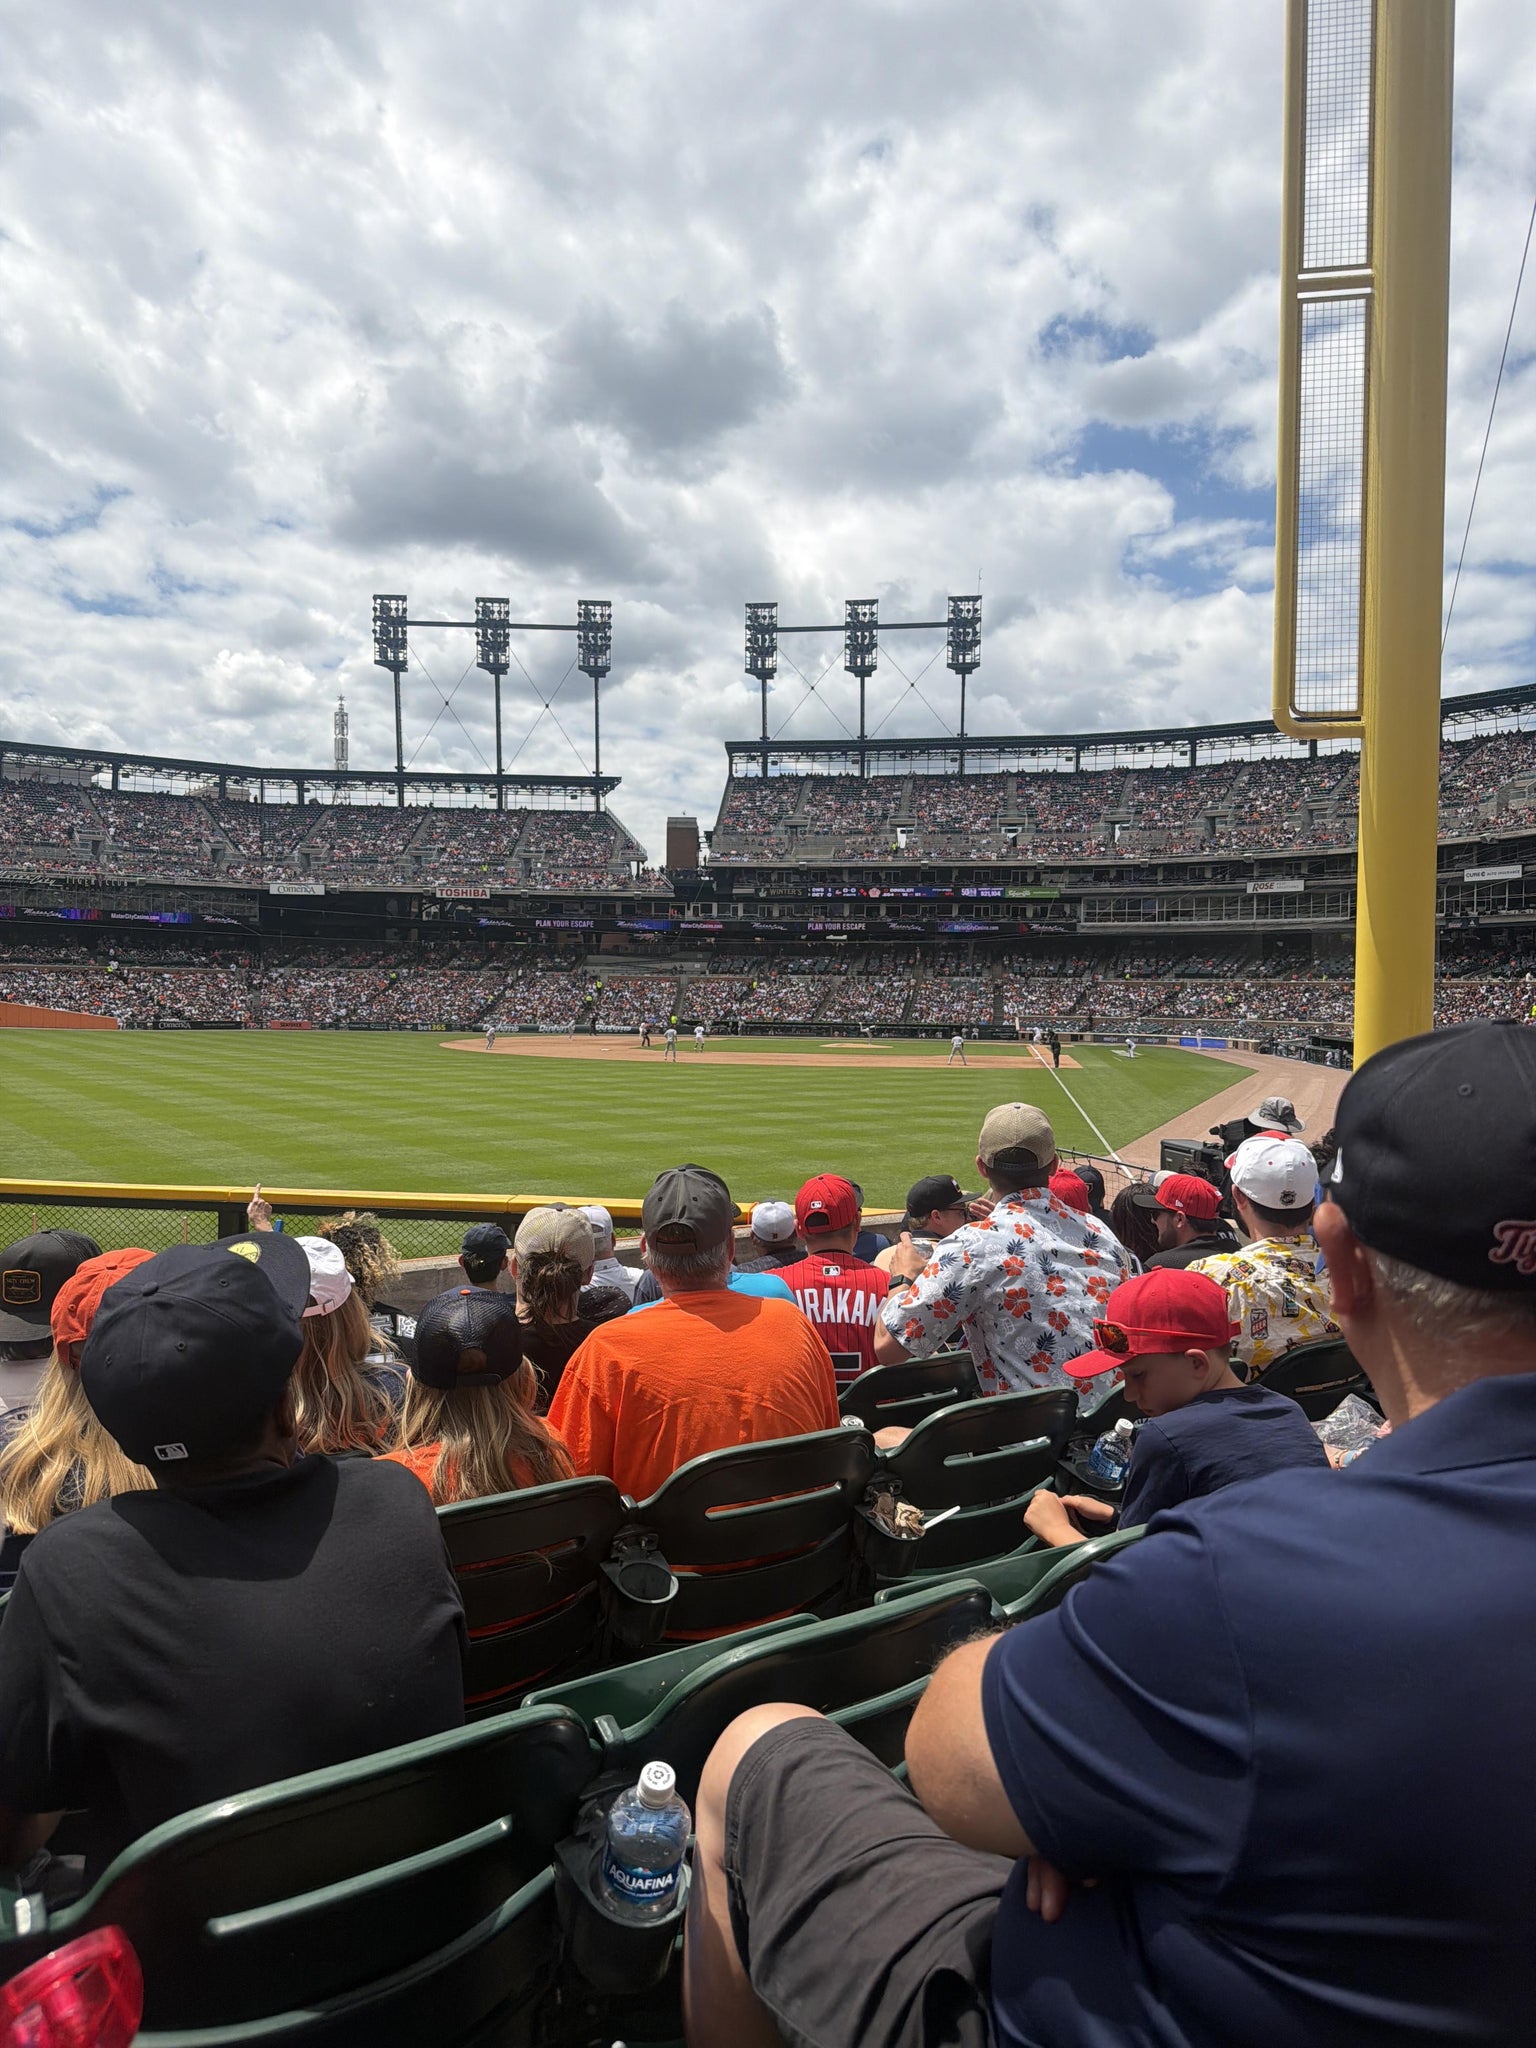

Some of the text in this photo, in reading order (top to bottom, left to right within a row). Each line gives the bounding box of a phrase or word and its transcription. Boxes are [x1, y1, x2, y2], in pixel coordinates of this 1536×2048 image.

[1252, 882, 1275, 892] ROSE
[438, 888, 488, 898] TOSHIBA
[535, 919, 594, 928] PLAN YOUR ESCAPE
[807, 922, 866, 931] PLAN YOUR ESCAPE
[417, 1023, 446, 1031] bet365
[609, 1863, 673, 1890] AQUAFINA
